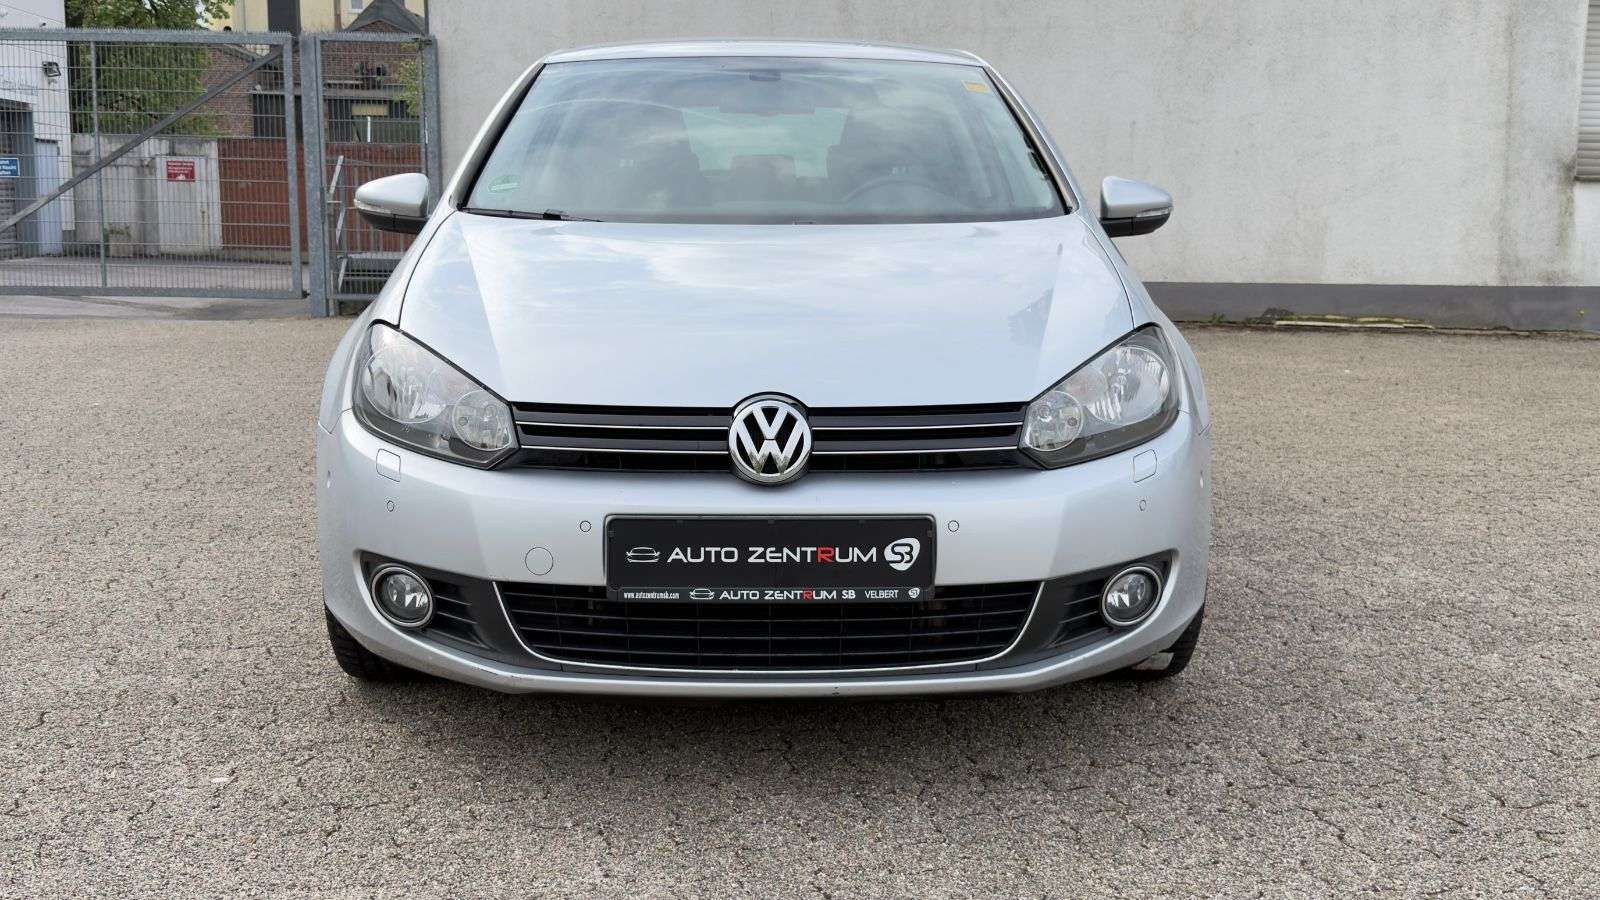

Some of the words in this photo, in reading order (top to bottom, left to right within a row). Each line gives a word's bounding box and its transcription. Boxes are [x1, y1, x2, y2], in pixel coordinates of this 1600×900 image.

[734, 403, 806, 476] VW
[667, 547, 738, 563] AUTO
[747, 547, 877, 563] ZENTRUM
[719, 590, 760, 600] AUTO
[764, 590, 837, 600] ZENTRUM
[841, 590, 857, 599] SB
[864, 589, 899, 599] VELBERT
